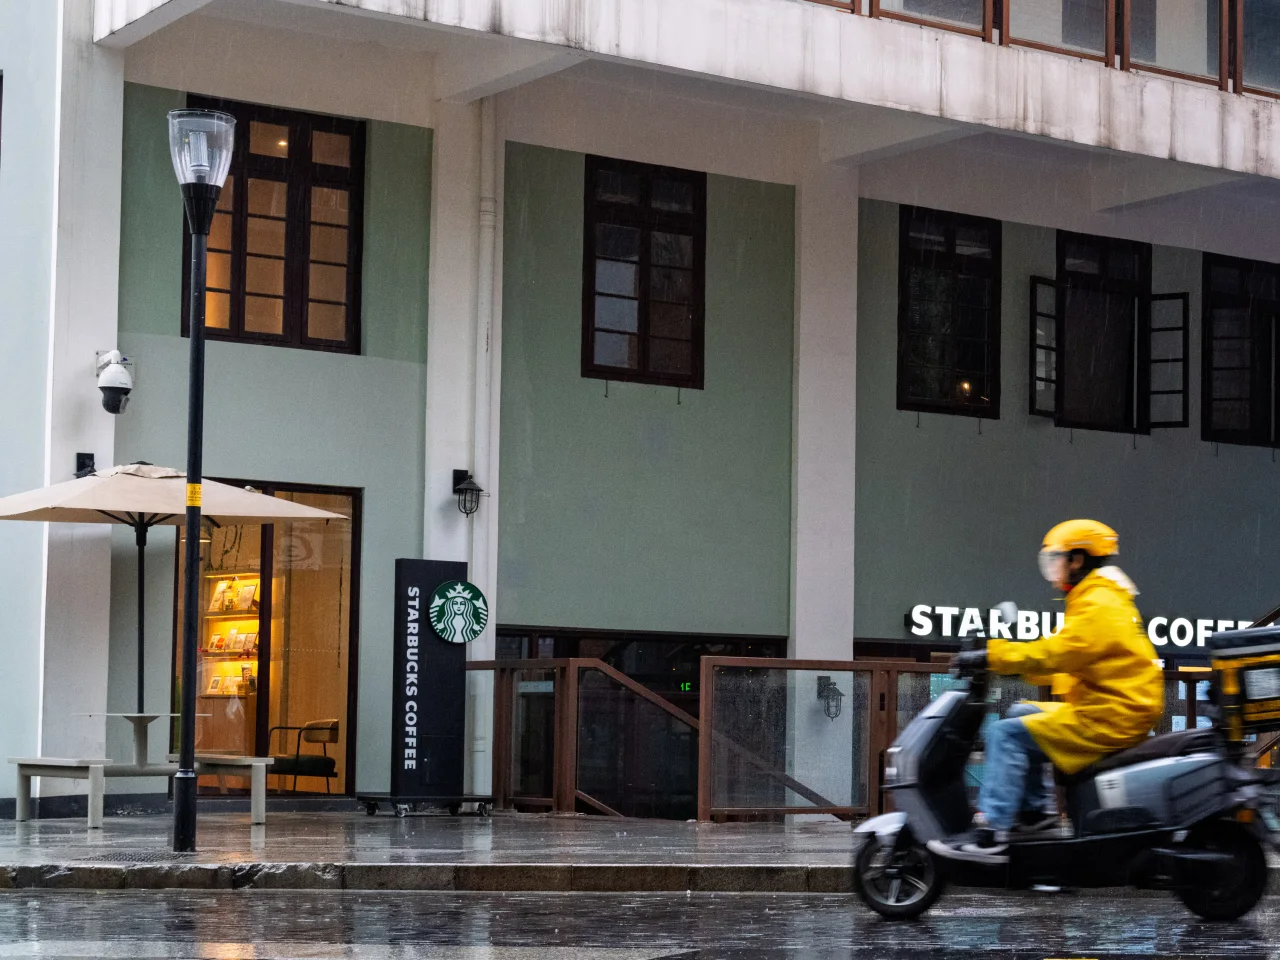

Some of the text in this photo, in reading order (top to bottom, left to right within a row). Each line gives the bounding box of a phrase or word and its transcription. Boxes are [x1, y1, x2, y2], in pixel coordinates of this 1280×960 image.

[404, 586, 420, 770] STARBUCKS COFFEE
[911, 604, 1275, 647] STARBU COF
